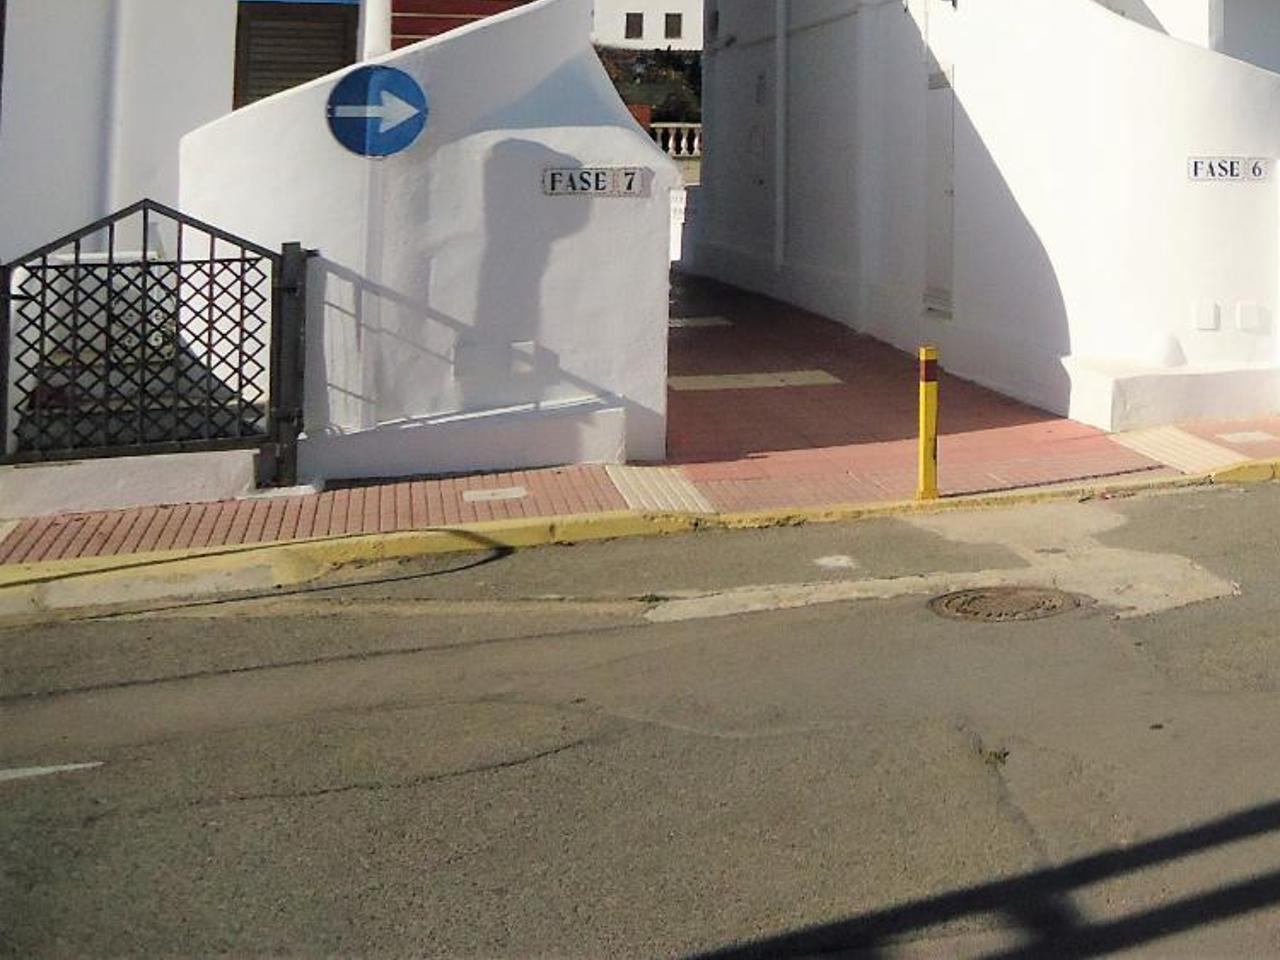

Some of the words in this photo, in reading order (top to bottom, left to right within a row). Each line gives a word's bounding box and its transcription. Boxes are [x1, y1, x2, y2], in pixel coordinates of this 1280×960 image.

[1193, 159, 1240, 177] FASE
[1252, 160, 1262, 177] 6
[549, 170, 608, 191] FASE
[624, 172, 636, 191] 7
